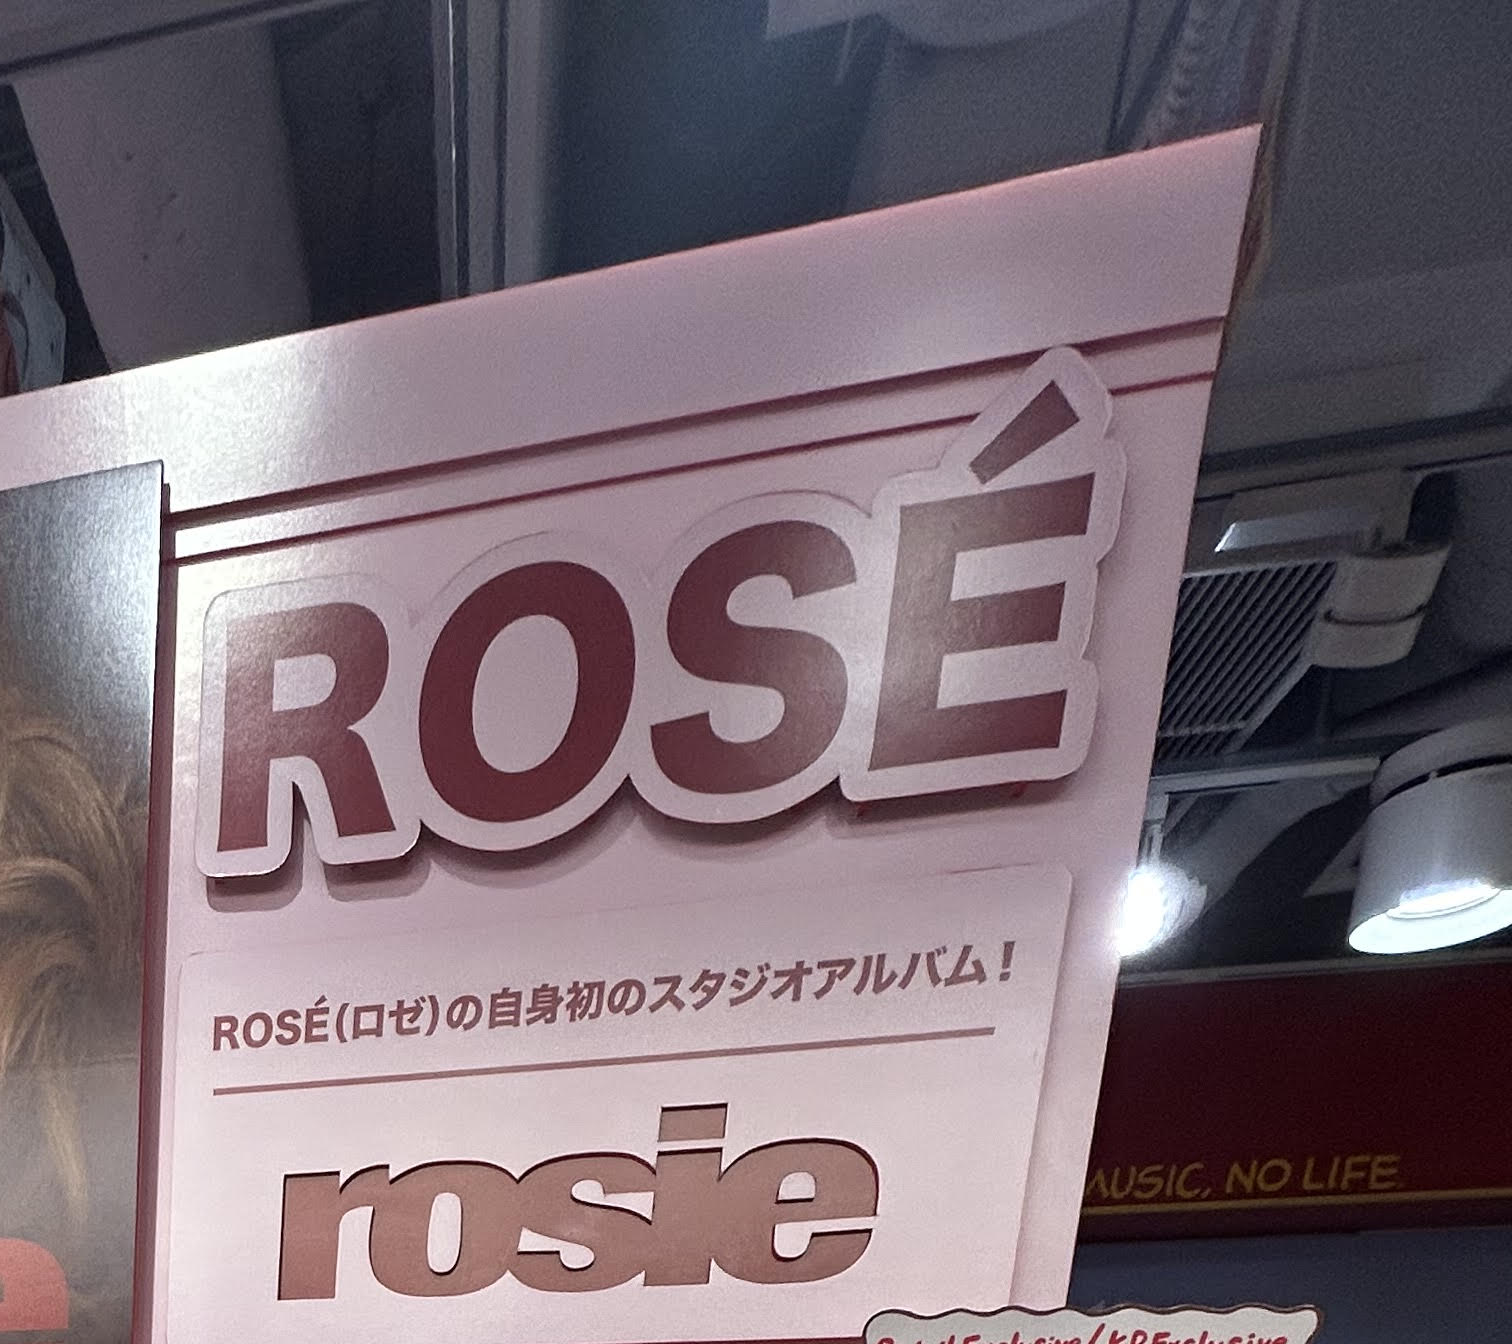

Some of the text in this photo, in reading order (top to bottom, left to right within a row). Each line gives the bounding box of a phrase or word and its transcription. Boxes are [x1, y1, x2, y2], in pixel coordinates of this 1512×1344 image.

[217, 380, 1096, 852] ROSÉ
[278, 1103, 879, 1301] rosie
[1226, 1158, 1290, 1193] NO
